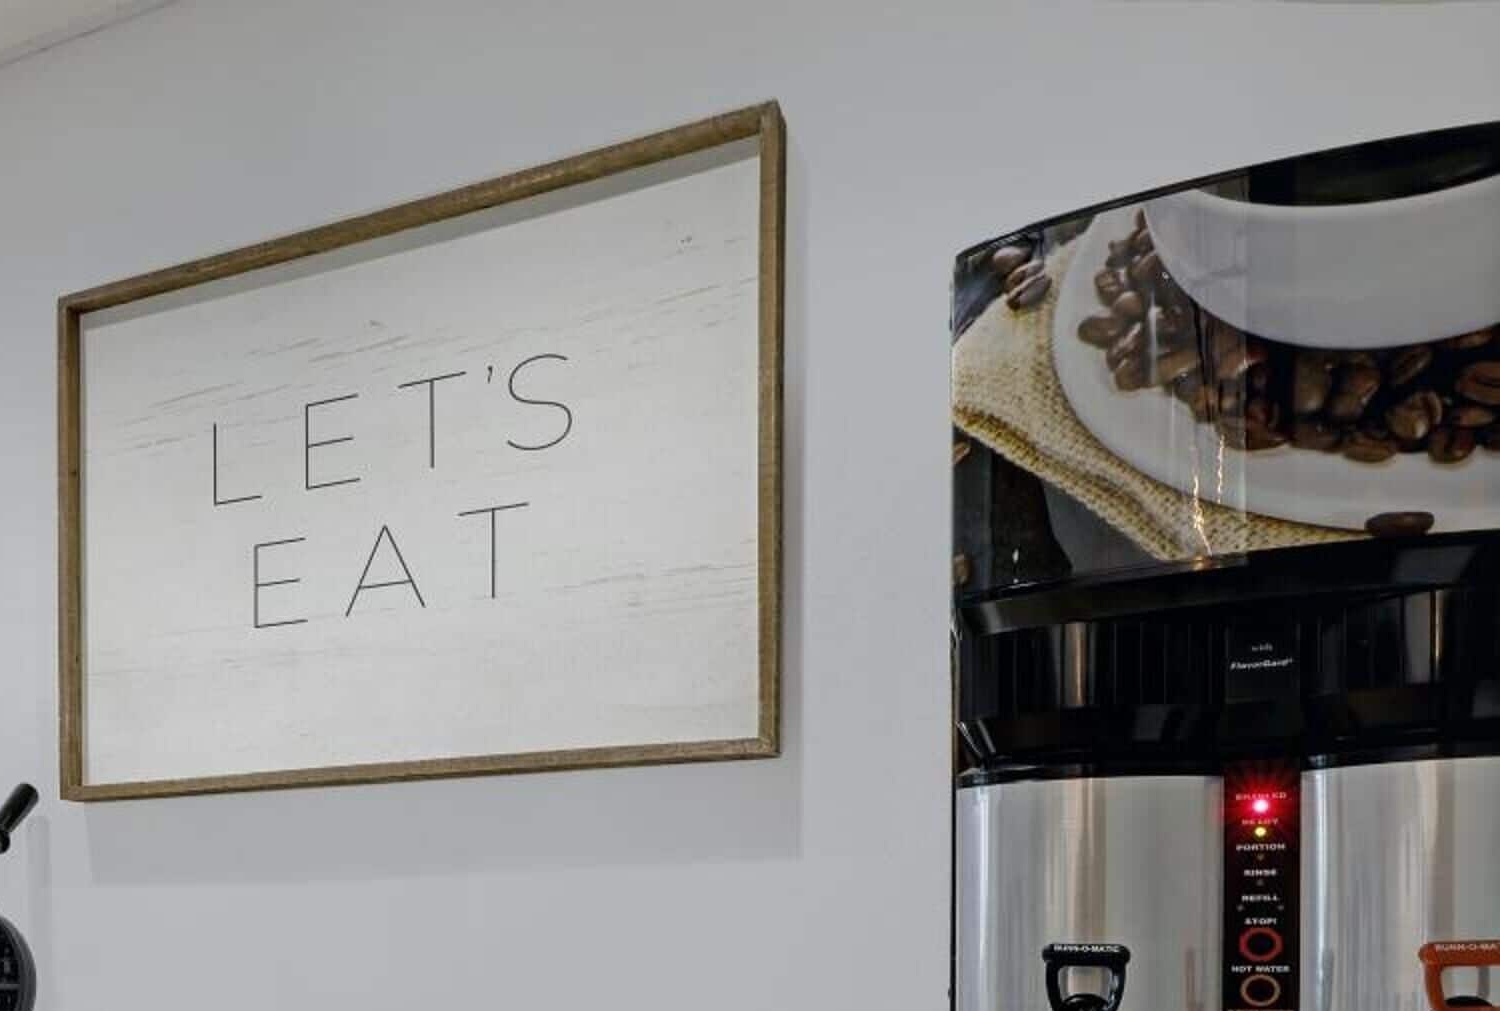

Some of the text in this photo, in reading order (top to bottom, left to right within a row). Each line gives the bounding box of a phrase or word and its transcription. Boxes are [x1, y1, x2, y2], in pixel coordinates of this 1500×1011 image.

[212, 353, 572, 506] LET'S
[253, 501, 530, 629] EAT
[1236, 843, 1287, 852] PORTION
[1231, 965, 1291, 973] HOT WATER
